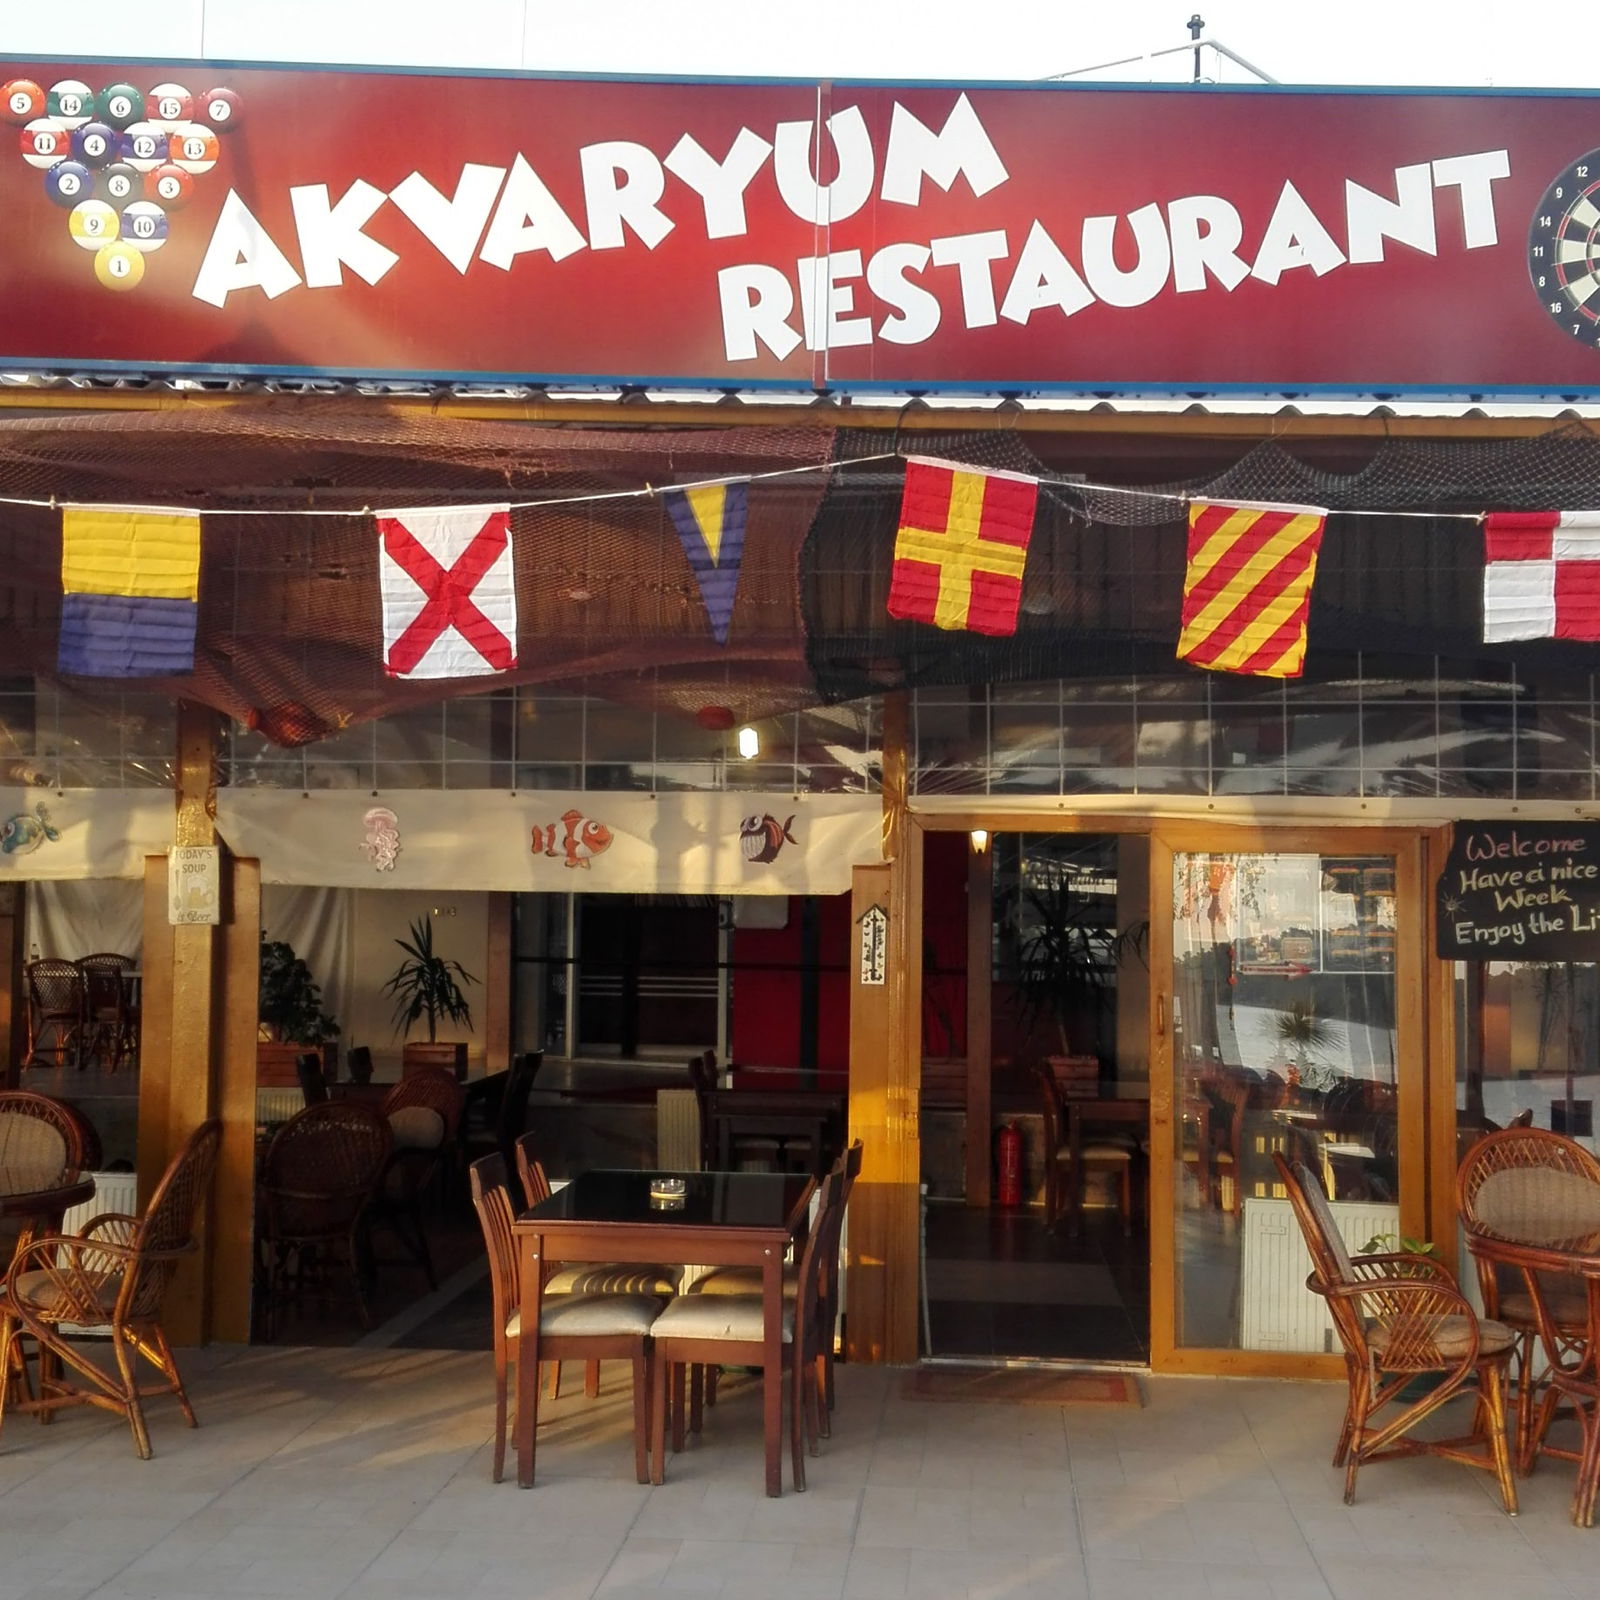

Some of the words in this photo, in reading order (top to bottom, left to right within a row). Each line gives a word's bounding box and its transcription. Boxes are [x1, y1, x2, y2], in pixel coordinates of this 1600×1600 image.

[16, 97, 25, 109] 5
[63, 99, 78, 111] 14
[116, 101, 125, 114] 6
[163, 102, 178, 114] 15
[215, 104, 224, 116] 7
[38, 138, 51, 150] 11
[90, 139, 99, 151] 4
[137, 141, 152, 152] 12
[187, 143, 202, 155] 13
[1577, 166, 1588, 177] 12
[65, 179, 74, 190] 2
[115, 180, 123, 191] 8
[165, 182, 173, 193] 3
[1556, 187, 1563, 198] 9
[192, 92, 1010, 308] AKVARYUM
[90, 219, 98, 232] 9
[137, 221, 152, 233] 10
[1540, 216, 1551, 227] 14
[717, 149, 1512, 362] RESTAURANT
[1533, 247, 1544, 257] 11
[1538, 276, 1546, 287] 8
[1550, 303, 1562, 313] 16
[1572, 324, 1580, 335] 7
[1466, 831, 1587, 861] Welcome
[182, 864, 207, 874] SOUP
[1460, 868, 1522, 894] Have
[1550, 858, 1598, 880] nice
[1494, 884, 1573, 912] Week
[1455, 921, 1526, 945] Enjoy
[1528, 912, 1565, 934] the
[1570, 904, 1600, 931] Li
